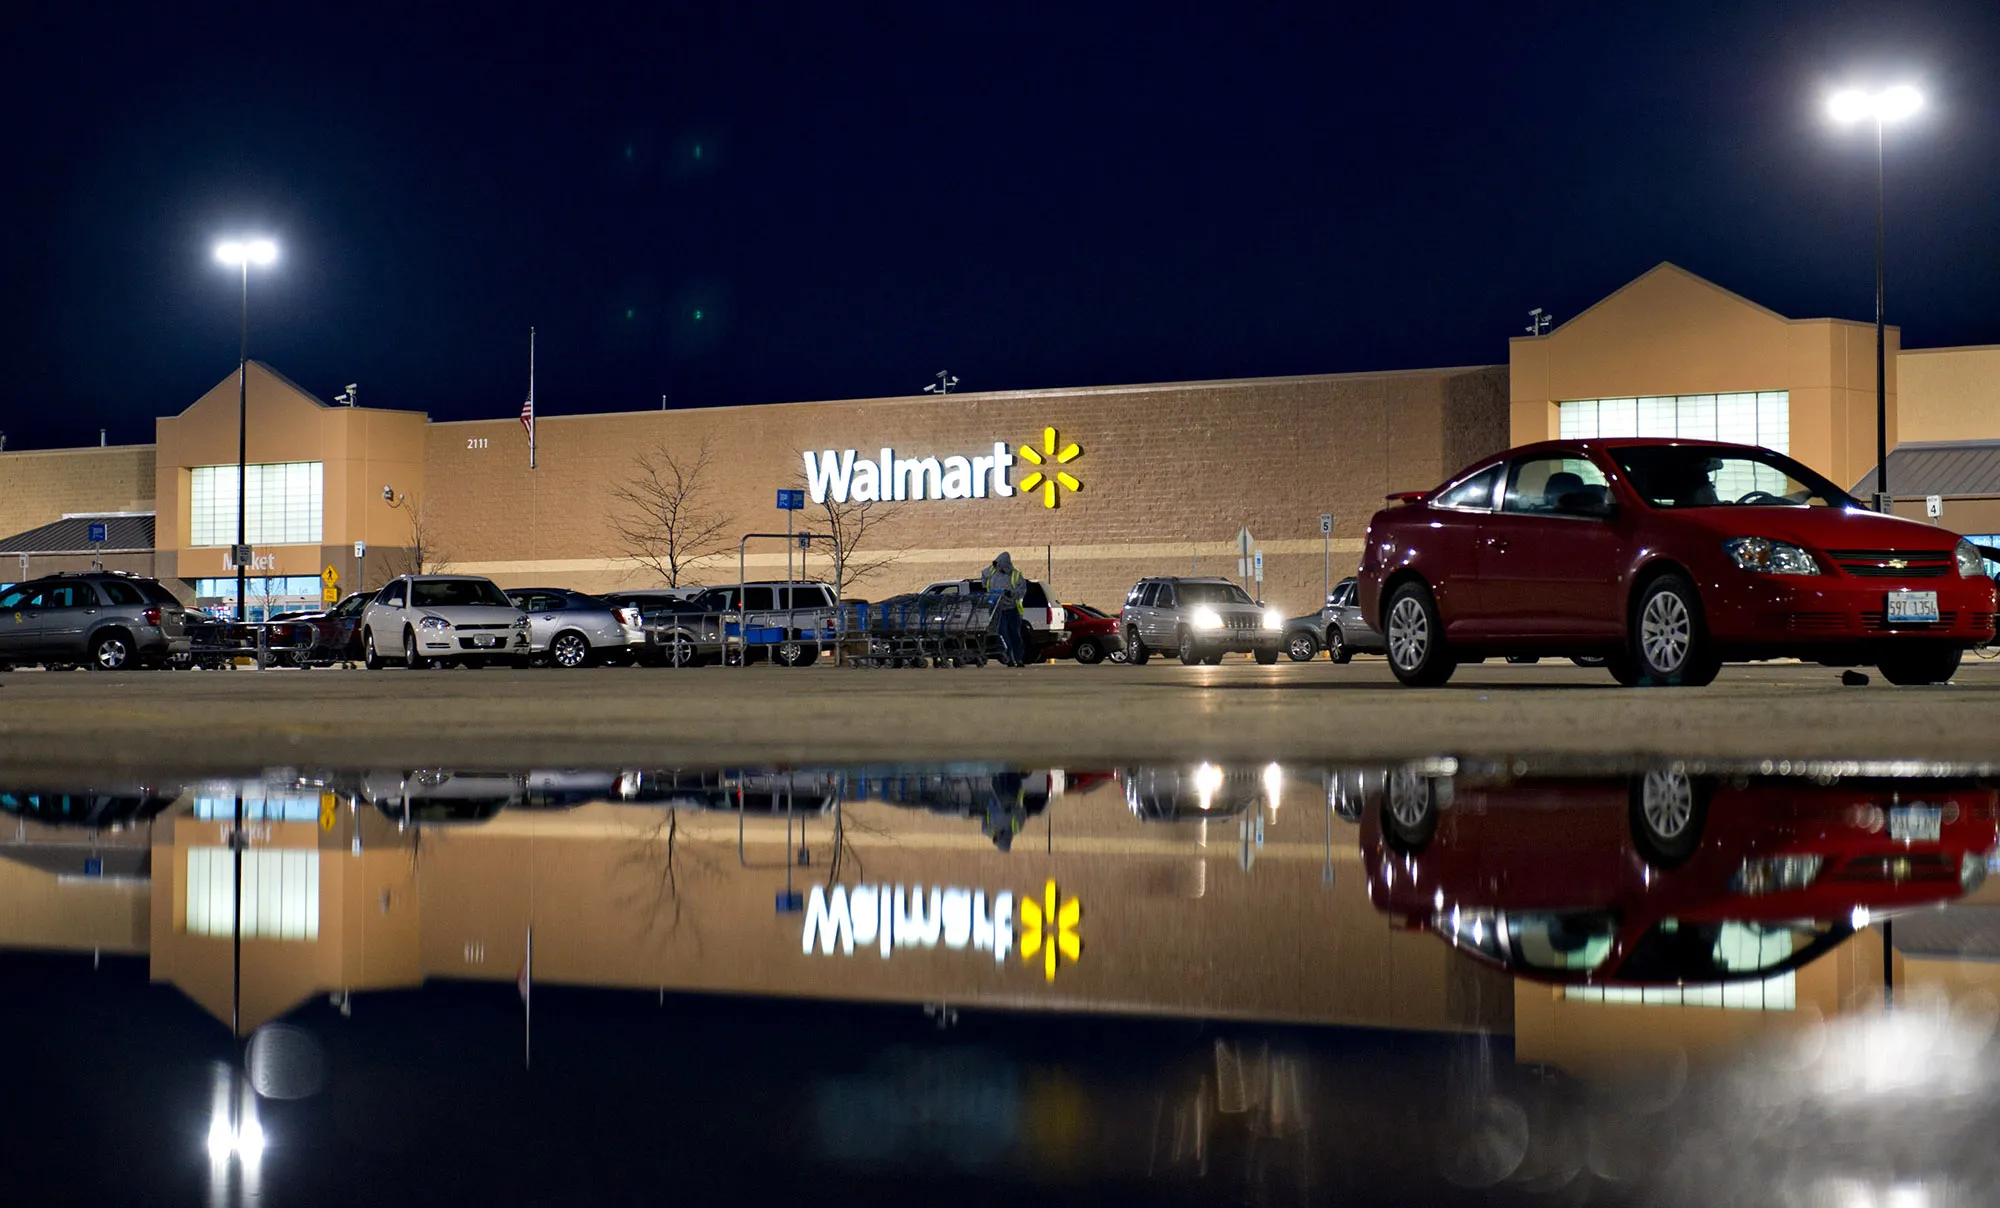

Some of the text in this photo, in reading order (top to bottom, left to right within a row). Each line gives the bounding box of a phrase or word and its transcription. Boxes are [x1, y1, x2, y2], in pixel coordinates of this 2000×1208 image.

[467, 438, 489, 449] 2111
[804, 441, 1013, 504] Walmart
[1930, 504, 1937, 514] 4
[1323, 521, 1329, 531] 5
[223, 551, 275, 571] Mket
[1890, 601, 1937, 616] 597 1354
